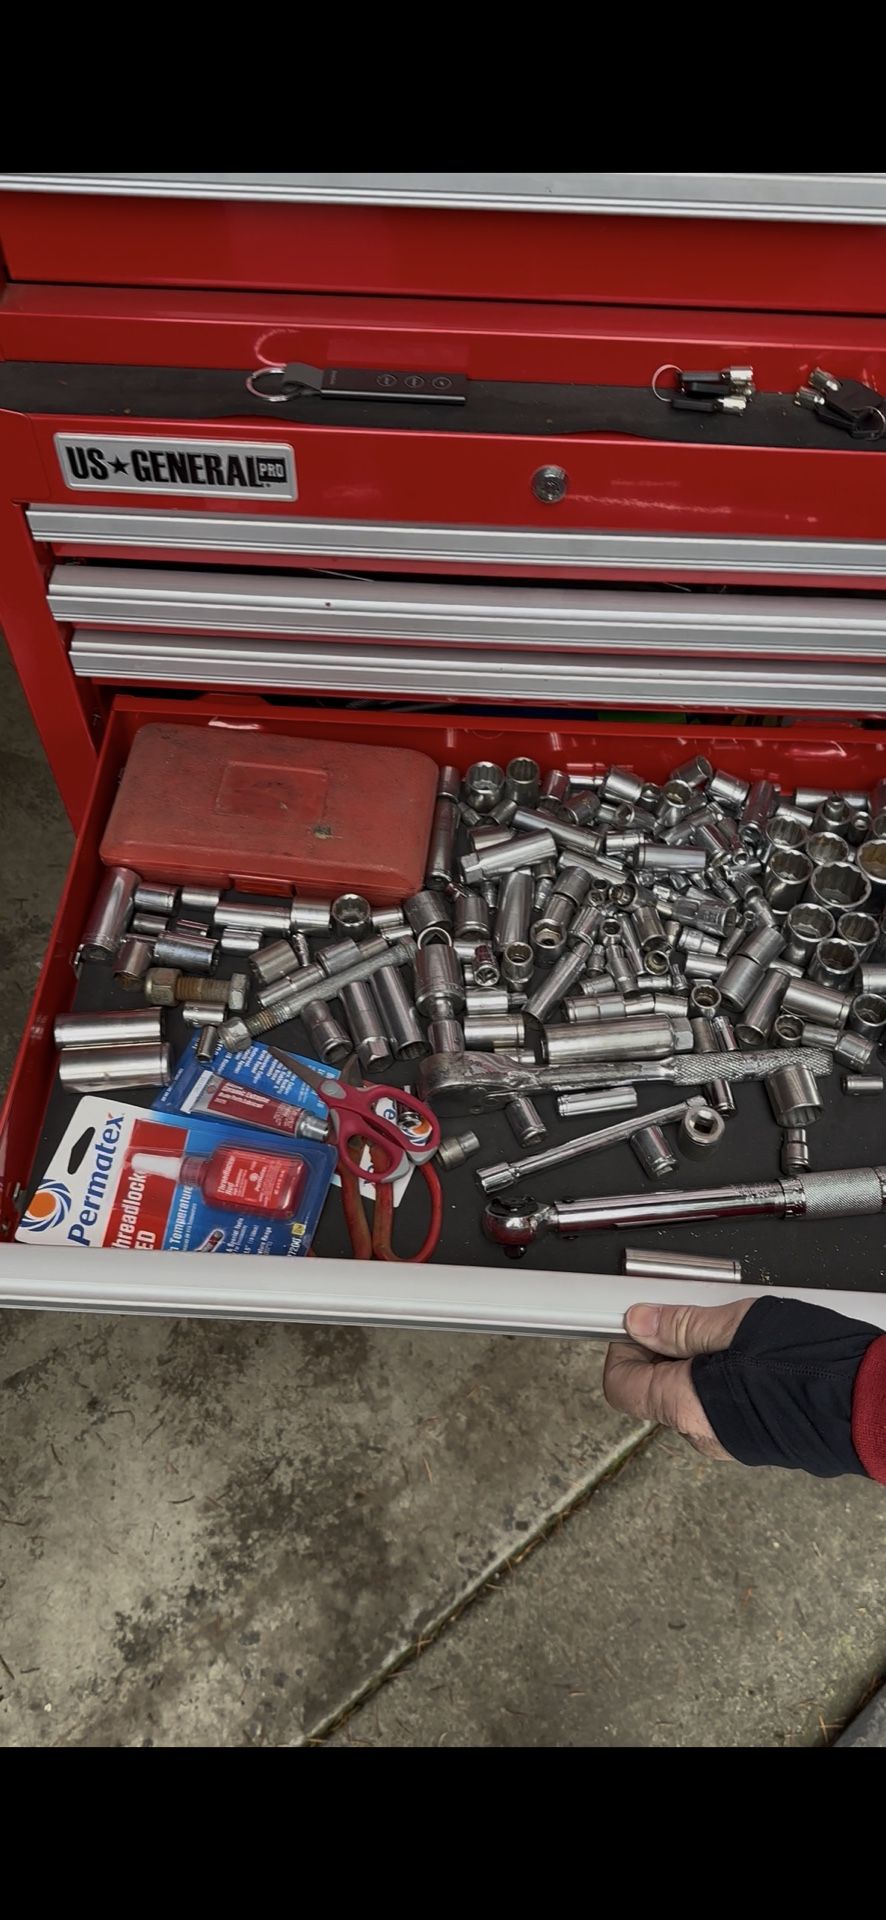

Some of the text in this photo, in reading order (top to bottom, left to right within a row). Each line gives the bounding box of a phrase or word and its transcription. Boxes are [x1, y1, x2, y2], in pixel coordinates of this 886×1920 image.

[65, 446, 284, 488] US GENERAL PRO
[67, 1113, 125, 1246] Permatex
[111, 1170, 147, 1249] hreadlock
[135, 1230, 156, 1250] ED
